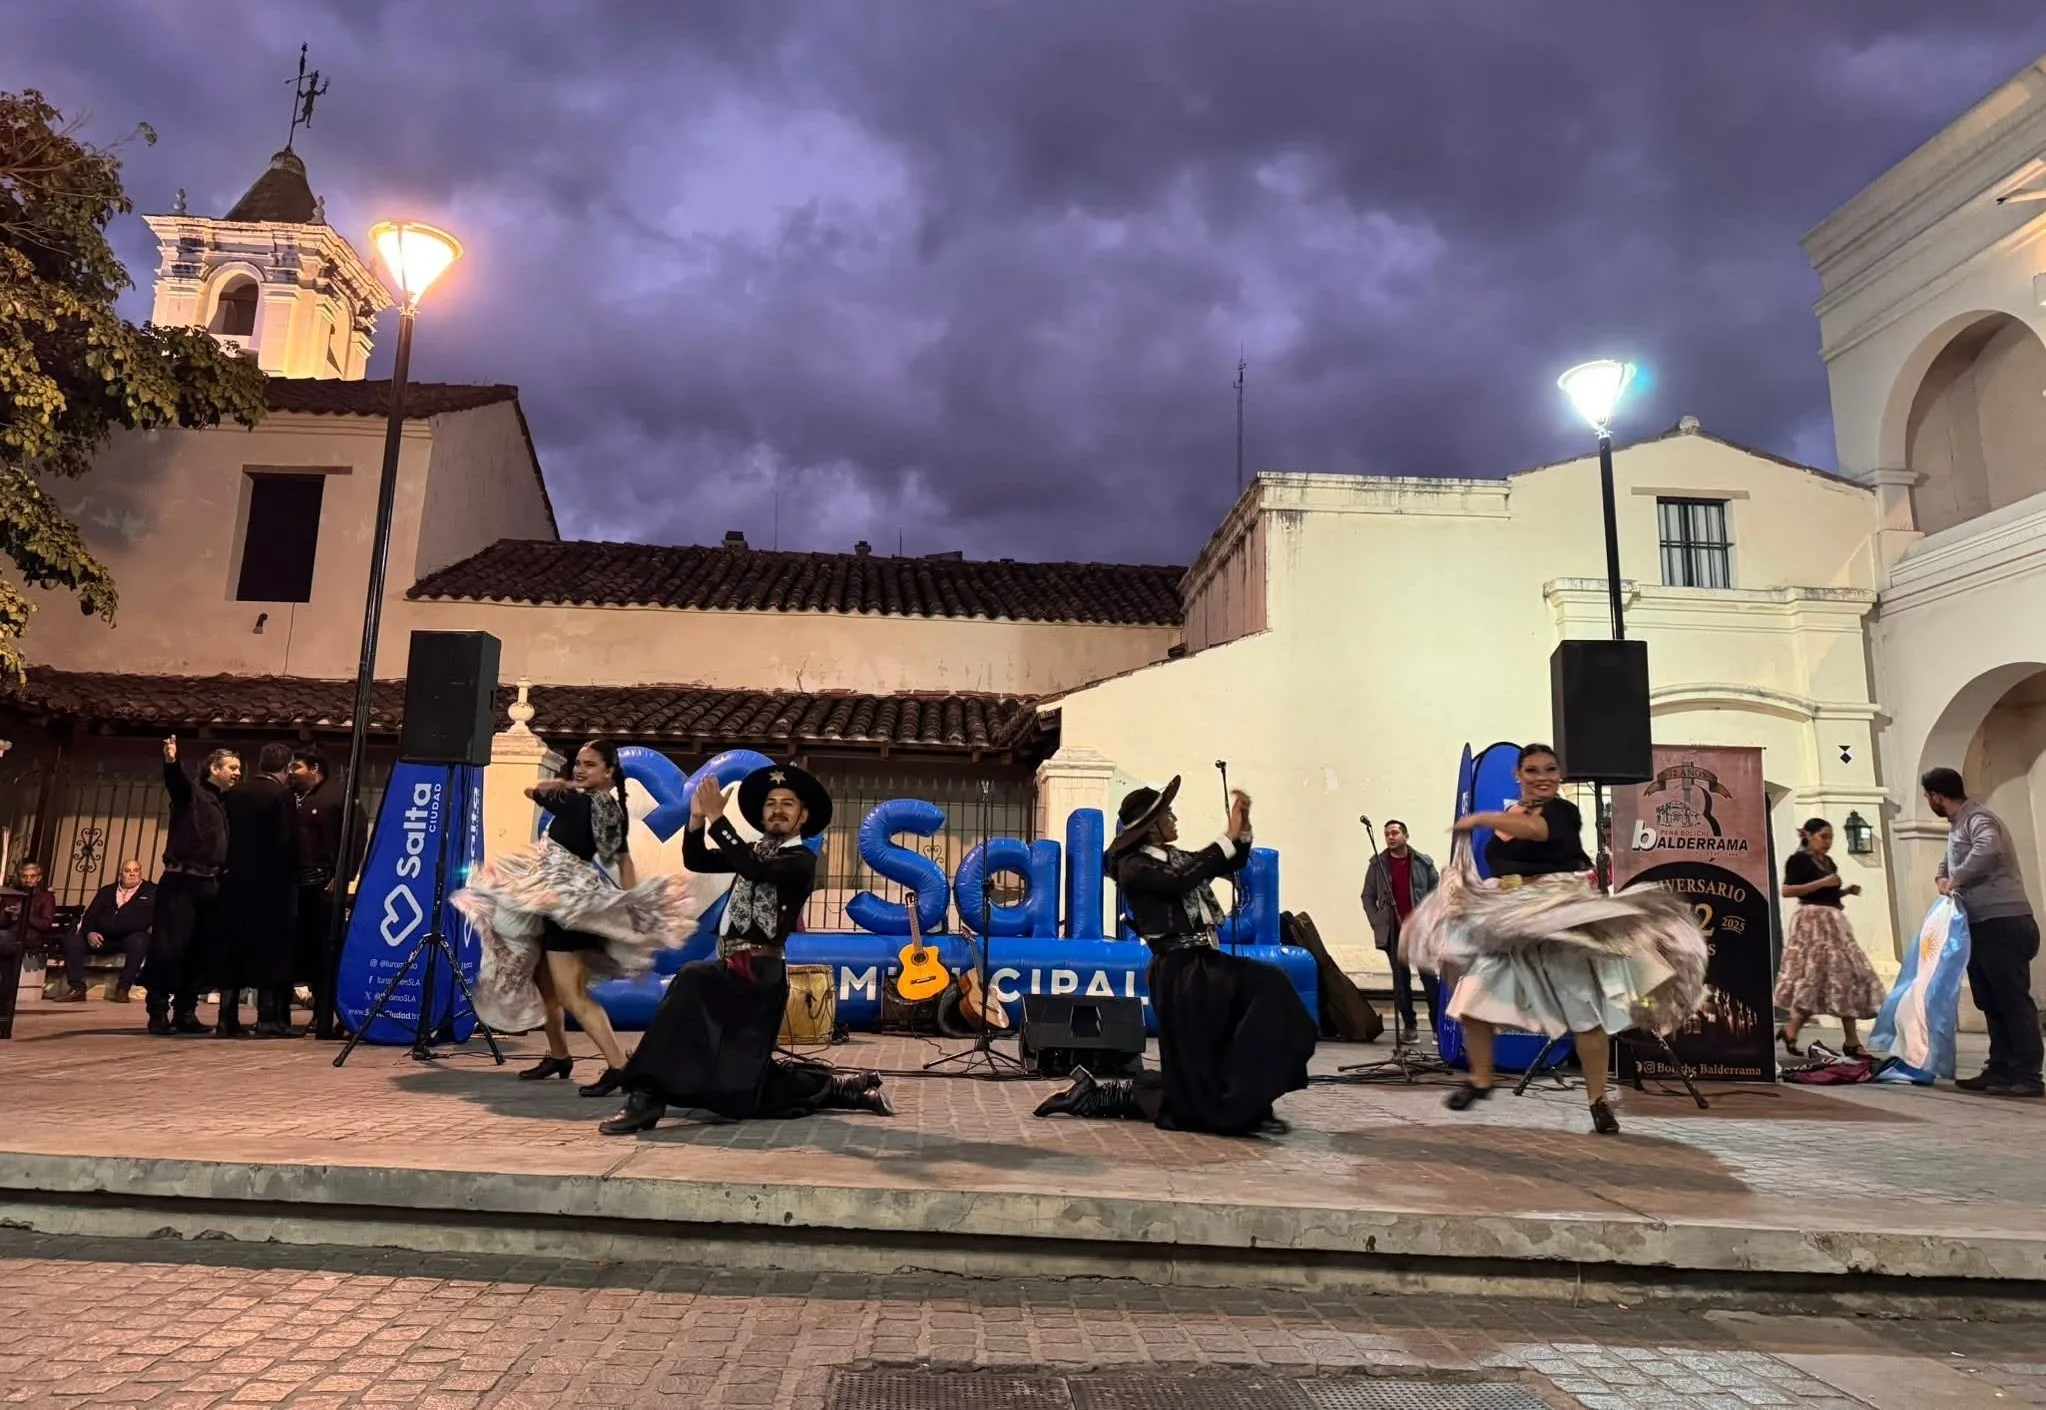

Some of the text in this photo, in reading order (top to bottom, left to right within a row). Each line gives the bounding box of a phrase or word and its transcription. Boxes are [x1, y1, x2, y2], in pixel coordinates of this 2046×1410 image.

[429, 783, 442, 833] CIUDAD
[845, 798, 1280, 946] Sala
[1721, 917, 1747, 932] 2025
[839, 965, 1150, 1006] MCIPAL
[1699, 1063, 1762, 1076] Balderrama
